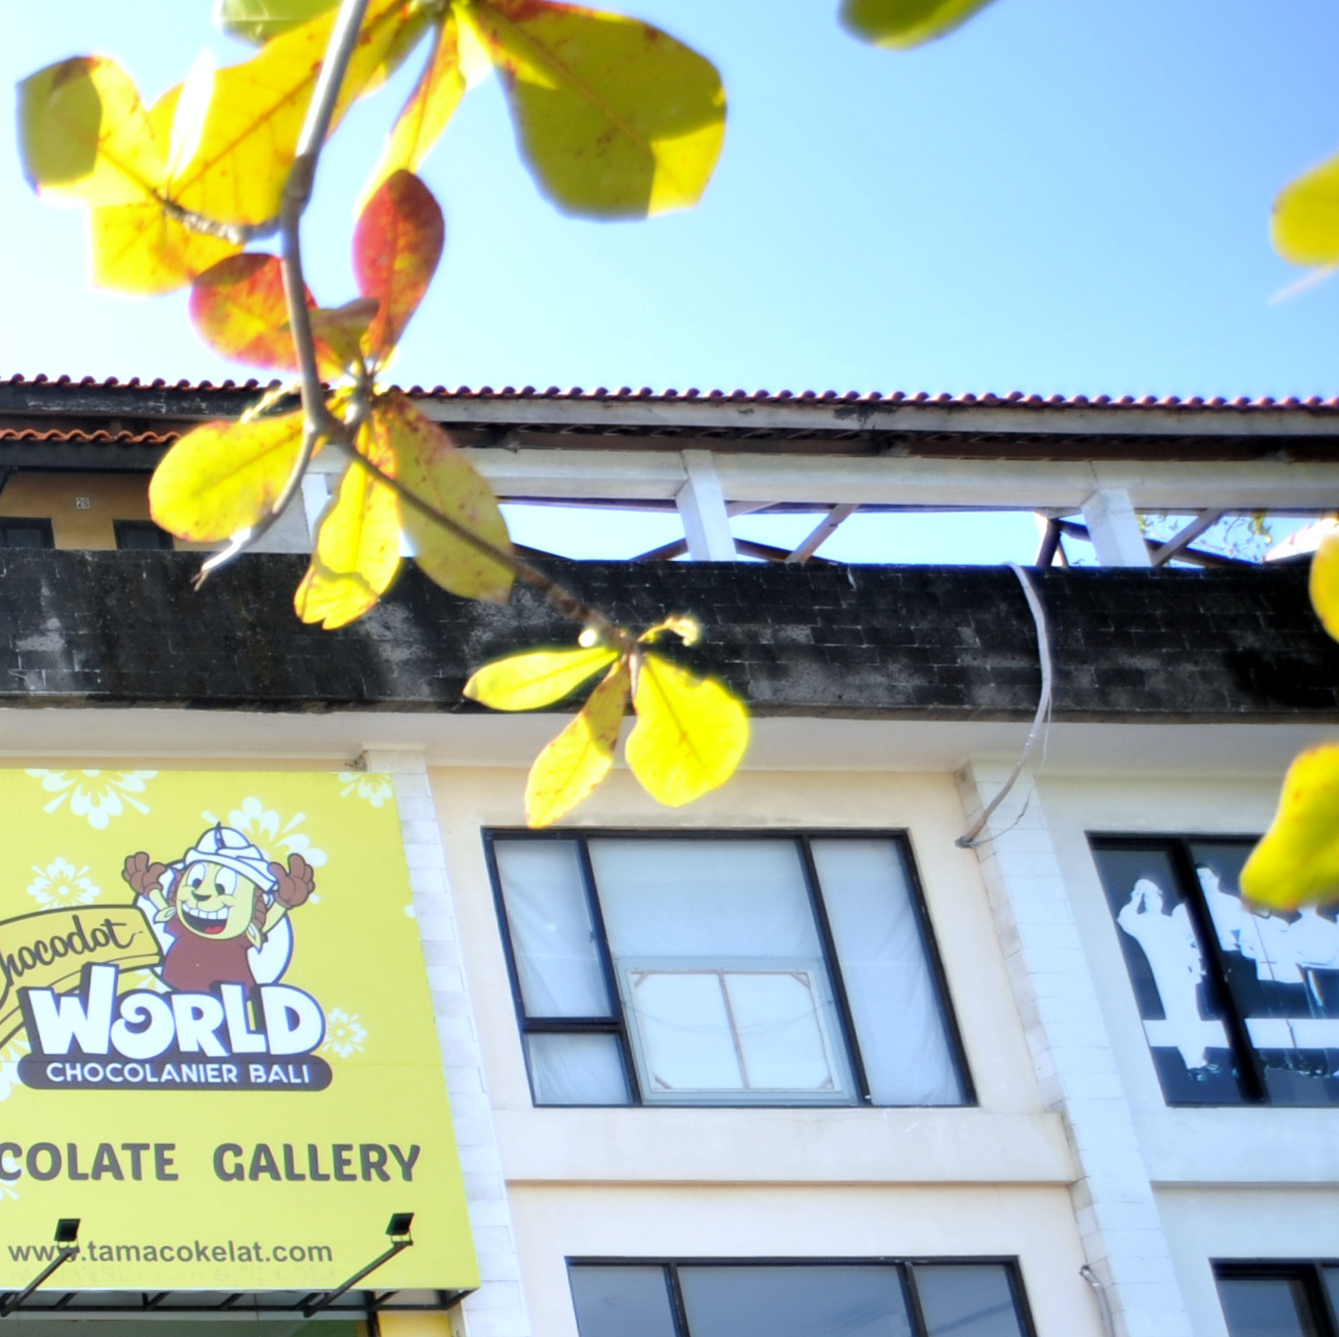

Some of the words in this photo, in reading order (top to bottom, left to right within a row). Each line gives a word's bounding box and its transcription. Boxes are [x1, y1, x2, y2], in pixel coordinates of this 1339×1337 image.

[27, 963, 325, 1059] WORLD
[45, 1061, 239, 1084] CHOCOLANIER
[249, 1063, 311, 1084] BALI
[213, 1142, 422, 1183] GALLERY
